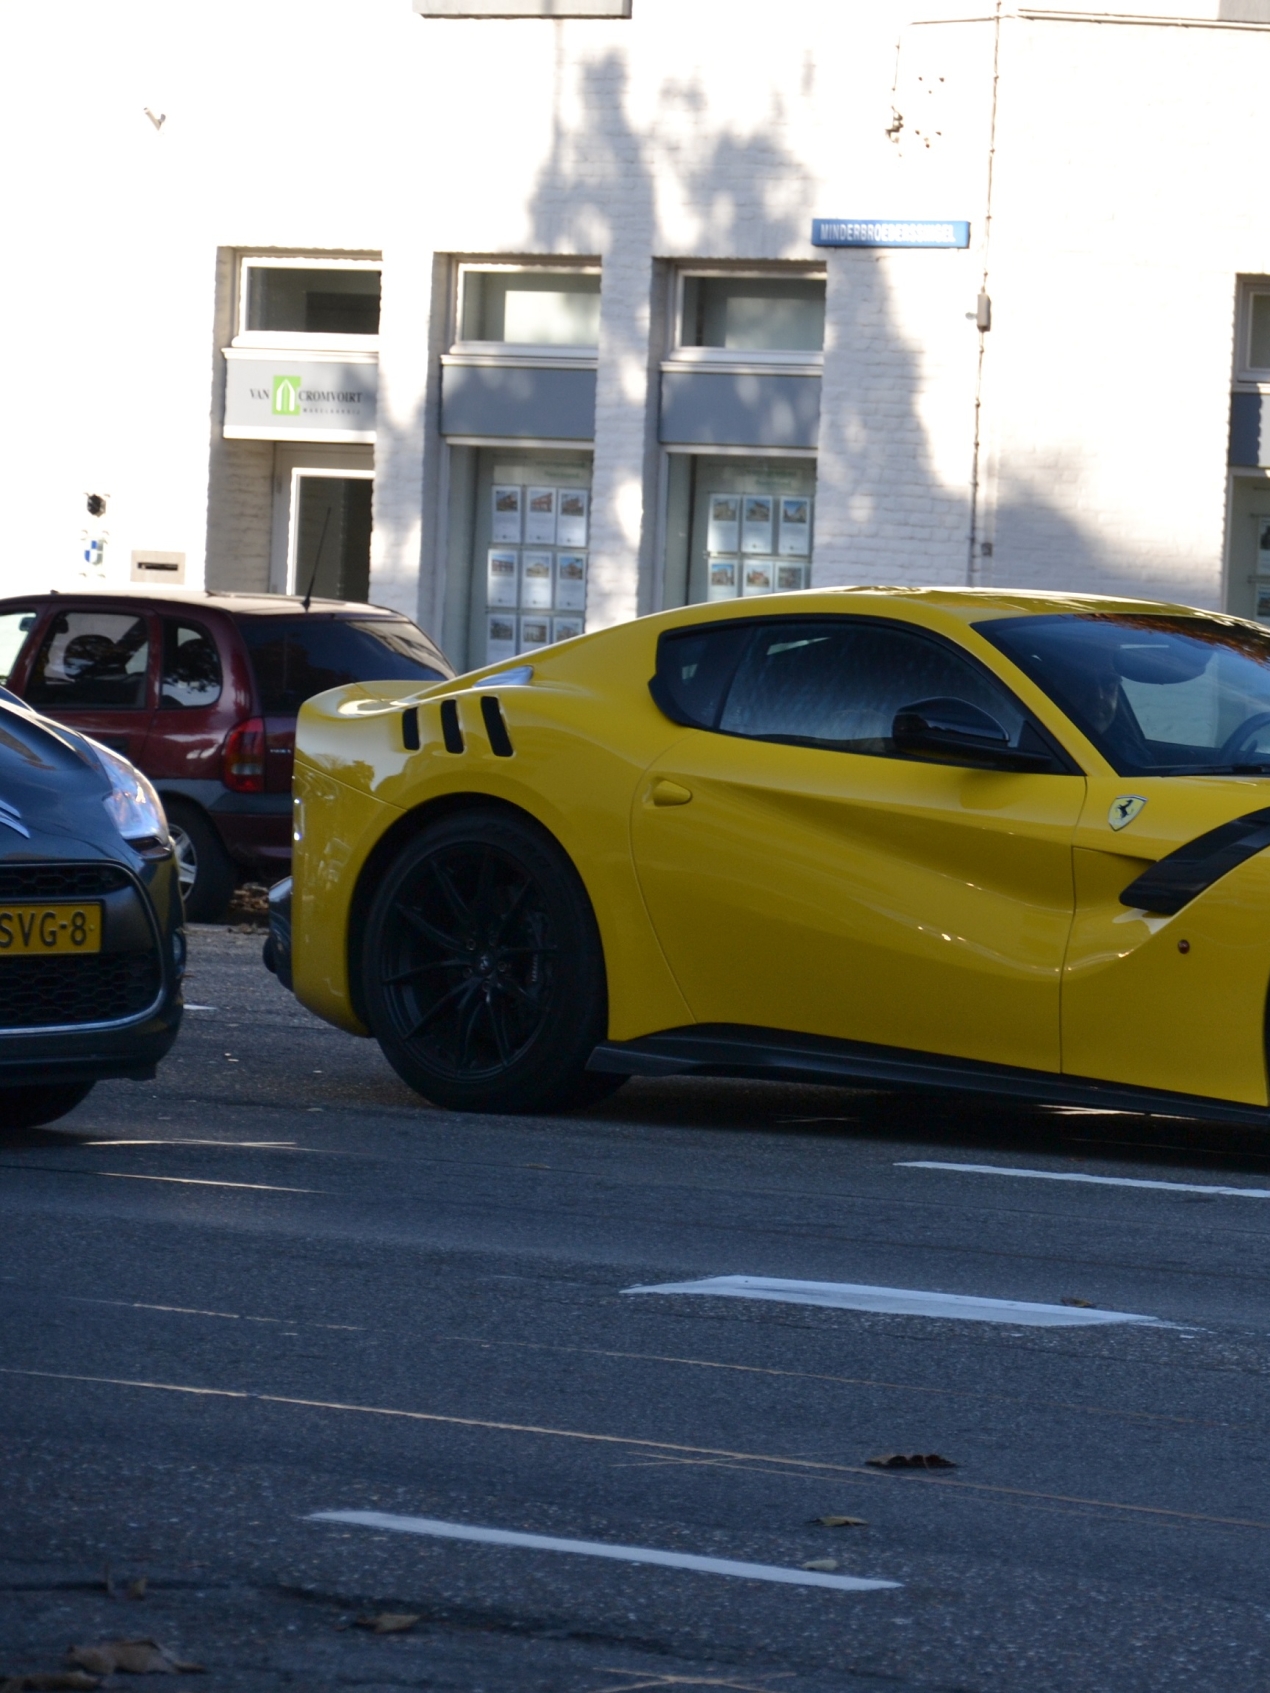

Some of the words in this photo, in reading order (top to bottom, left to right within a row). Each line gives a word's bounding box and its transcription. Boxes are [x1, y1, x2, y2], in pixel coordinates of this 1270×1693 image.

[249, 388, 270, 400] VAN
[297, 390, 363, 404] CROMVOIRT
[0, 911, 87, 948] SVG-8
